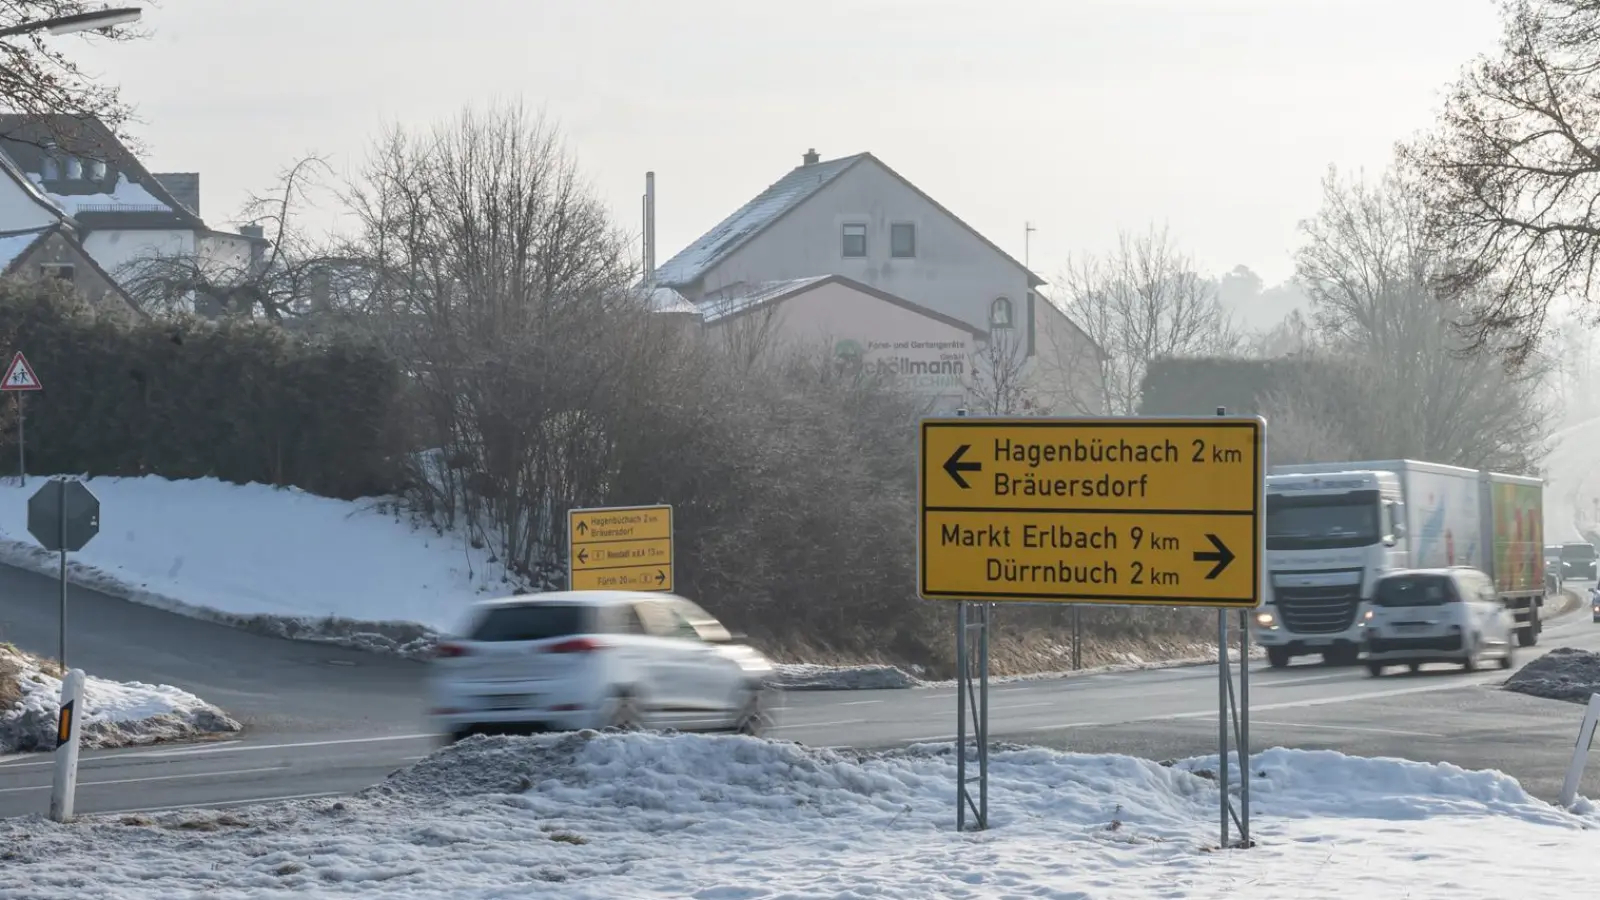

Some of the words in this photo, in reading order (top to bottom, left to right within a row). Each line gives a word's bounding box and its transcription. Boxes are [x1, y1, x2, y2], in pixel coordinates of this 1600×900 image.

[893, 341, 909, 349] und
[994, 438, 1179, 468] Hagenbüchach
[1191, 438, 1205, 462] 2
[1212, 445, 1242, 463] km
[994, 473, 1147, 497] Bräuersdorf
[591, 516, 642, 527] Hagenbüchach
[643, 514, 648, 523] 2
[591, 527, 633, 538] Bräuersdorf
[941, 523, 1011, 548] Markt
[1023, 524, 1117, 549] Erlbach
[1130, 526, 1144, 550] 9
[1151, 532, 1179, 551] km
[619, 576, 628, 585] 20
[986, 558, 1117, 583] Dürrnbuch
[1130, 561, 1144, 585] 2
[1151, 567, 1179, 586] km
